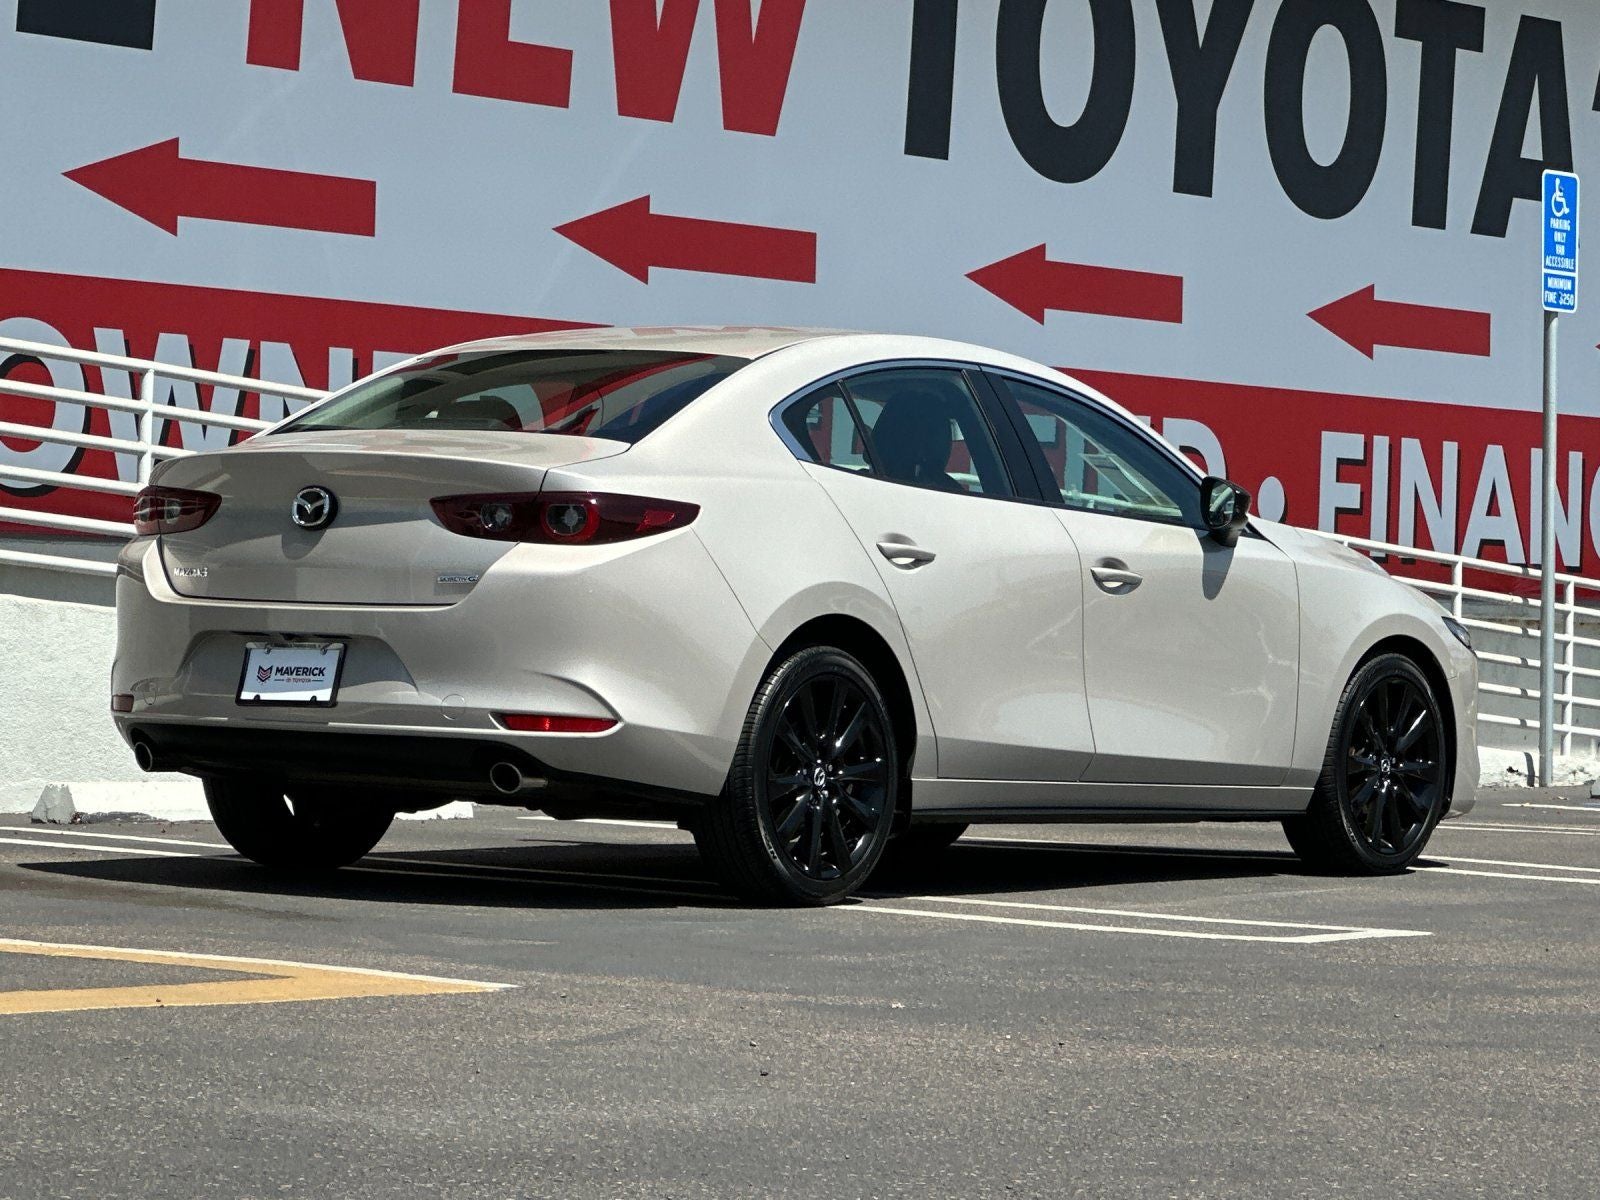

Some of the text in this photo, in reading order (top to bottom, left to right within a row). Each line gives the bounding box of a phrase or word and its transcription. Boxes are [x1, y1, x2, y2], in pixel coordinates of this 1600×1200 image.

[1550, 217, 1571, 231] PARKING
[1554, 231, 1567, 243] ONLY
[1545, 255, 1574, 270] ACCESSIBLE
[1547, 277, 1572, 291] MINIMUM
[1544, 290, 1557, 304] FINE
[1317, 430, 1600, 568] FINAN
[274, 666, 326, 677] MAVERICK
